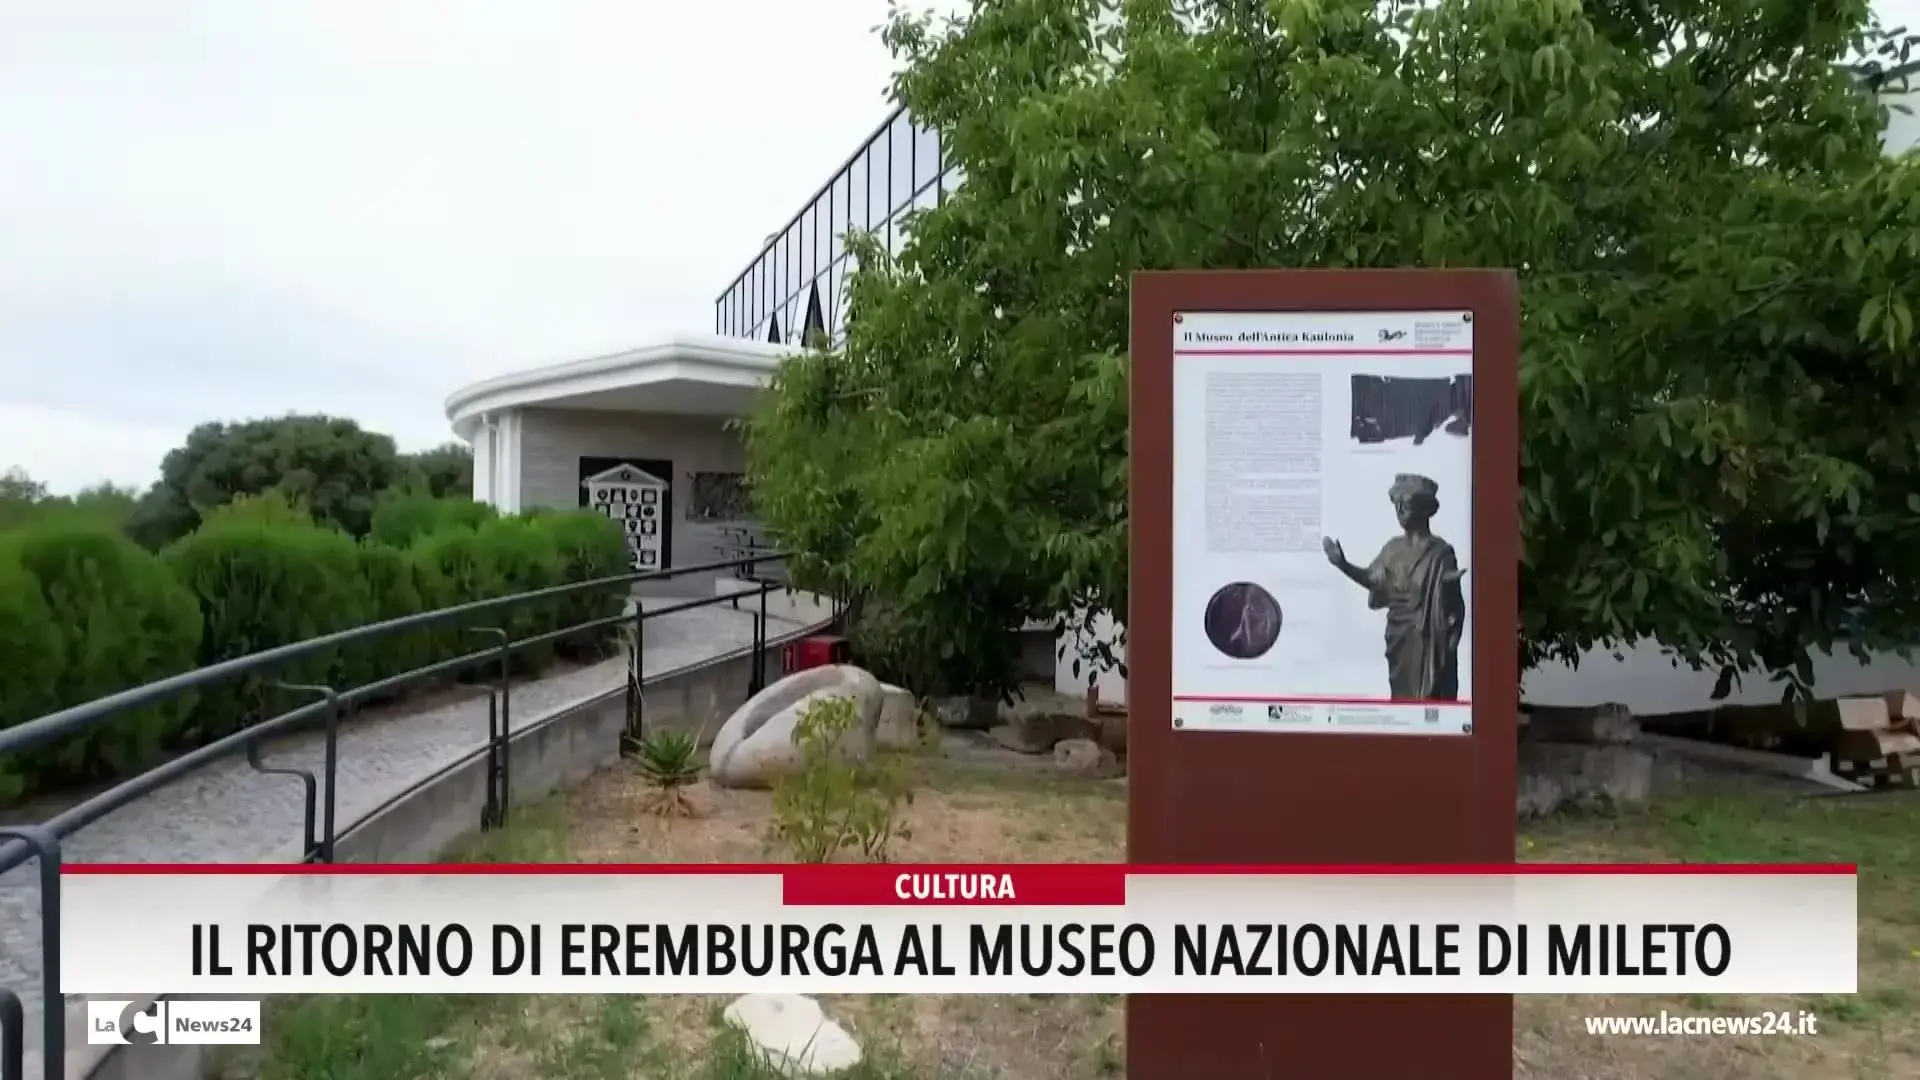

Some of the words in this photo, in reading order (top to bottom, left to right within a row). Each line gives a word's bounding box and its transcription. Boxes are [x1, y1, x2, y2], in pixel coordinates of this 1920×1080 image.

[1195, 332, 1233, 342] Museo
[1238, 331, 1298, 342] dell'Antica
[1302, 331, 1355, 342] Kaulonia
